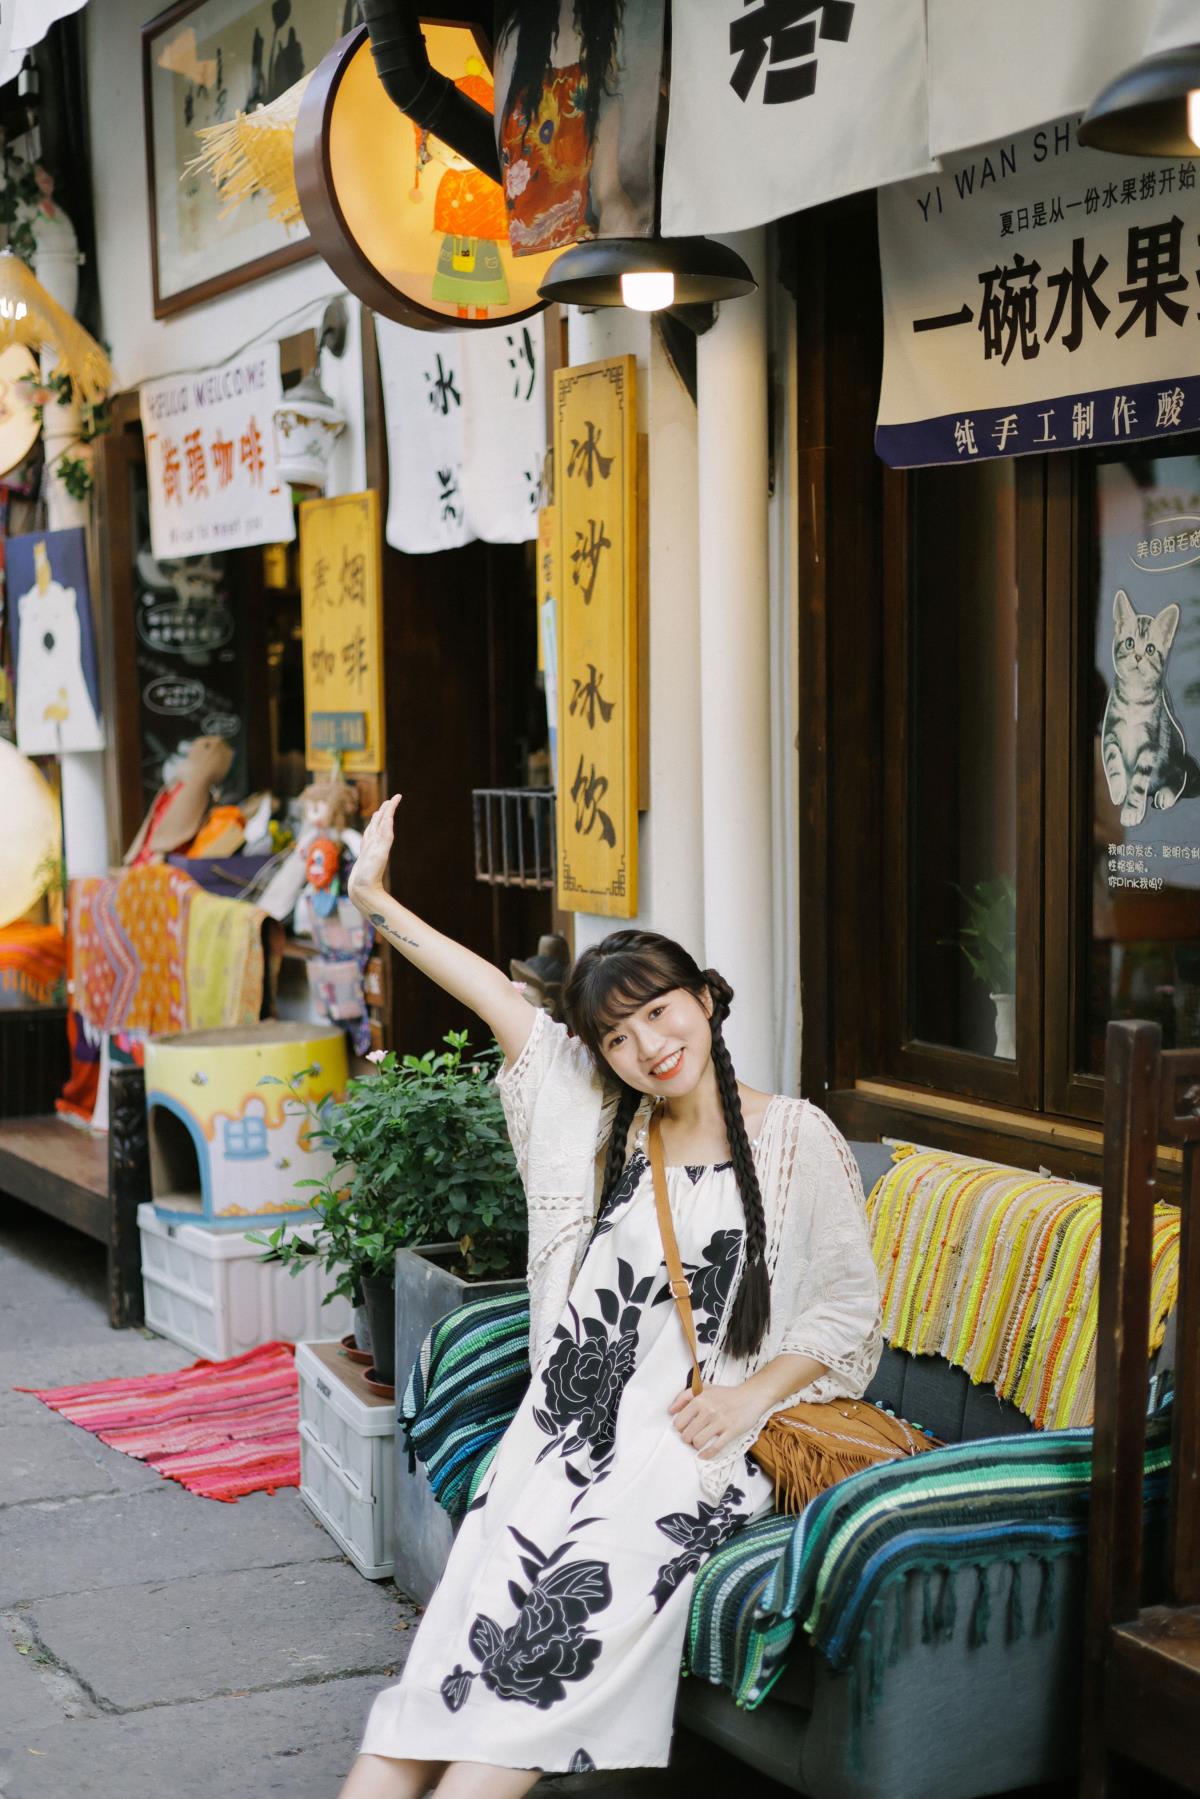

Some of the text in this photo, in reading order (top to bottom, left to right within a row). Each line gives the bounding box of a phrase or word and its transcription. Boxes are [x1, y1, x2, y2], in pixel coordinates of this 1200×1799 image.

[917, 186, 943, 223] YI
[954, 144, 1017, 199] WAN
[1000, 161, 1196, 237] 夏日是从一份水果捞开始
[913, 214, 1200, 367] 一碗水果
[193, 360, 266, 408] WELCOME
[954, 387, 1200, 455] 纯手工制作酸
